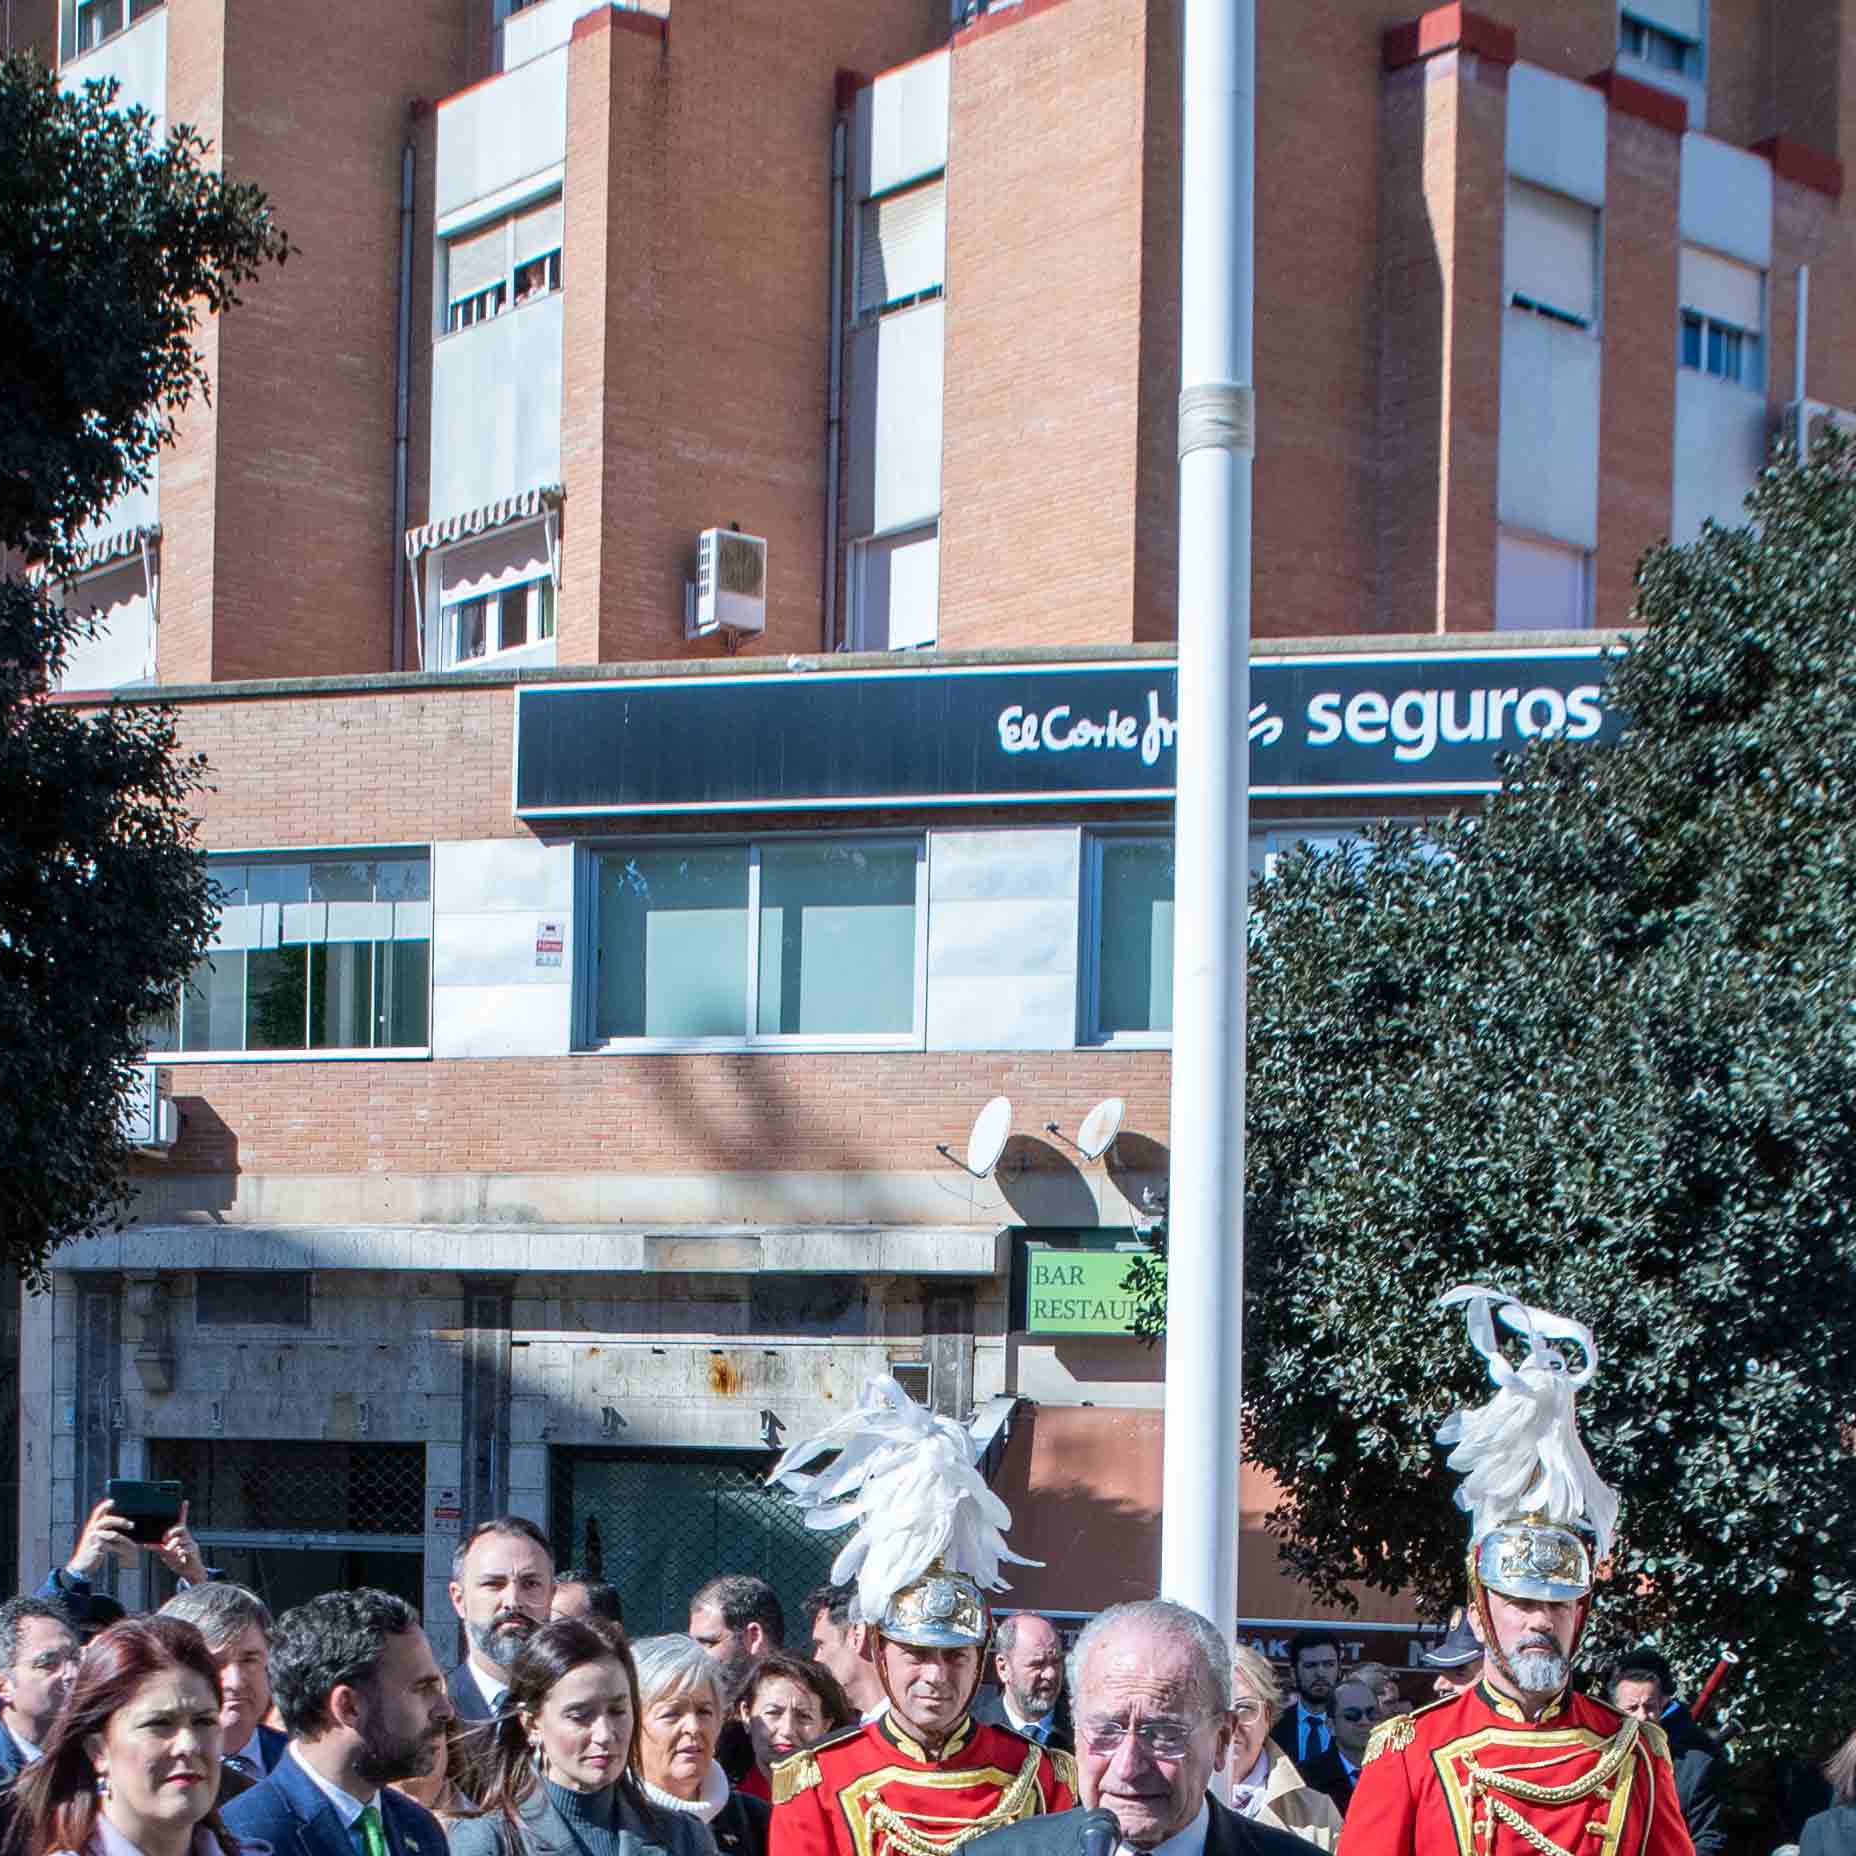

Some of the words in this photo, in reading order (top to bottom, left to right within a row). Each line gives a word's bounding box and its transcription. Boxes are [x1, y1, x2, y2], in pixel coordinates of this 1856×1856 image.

[998, 704, 1041, 751] El
[1042, 704, 1137, 750] Corte
[1306, 684, 1602, 762] seguros
[1035, 1265, 1086, 1286] BAR
